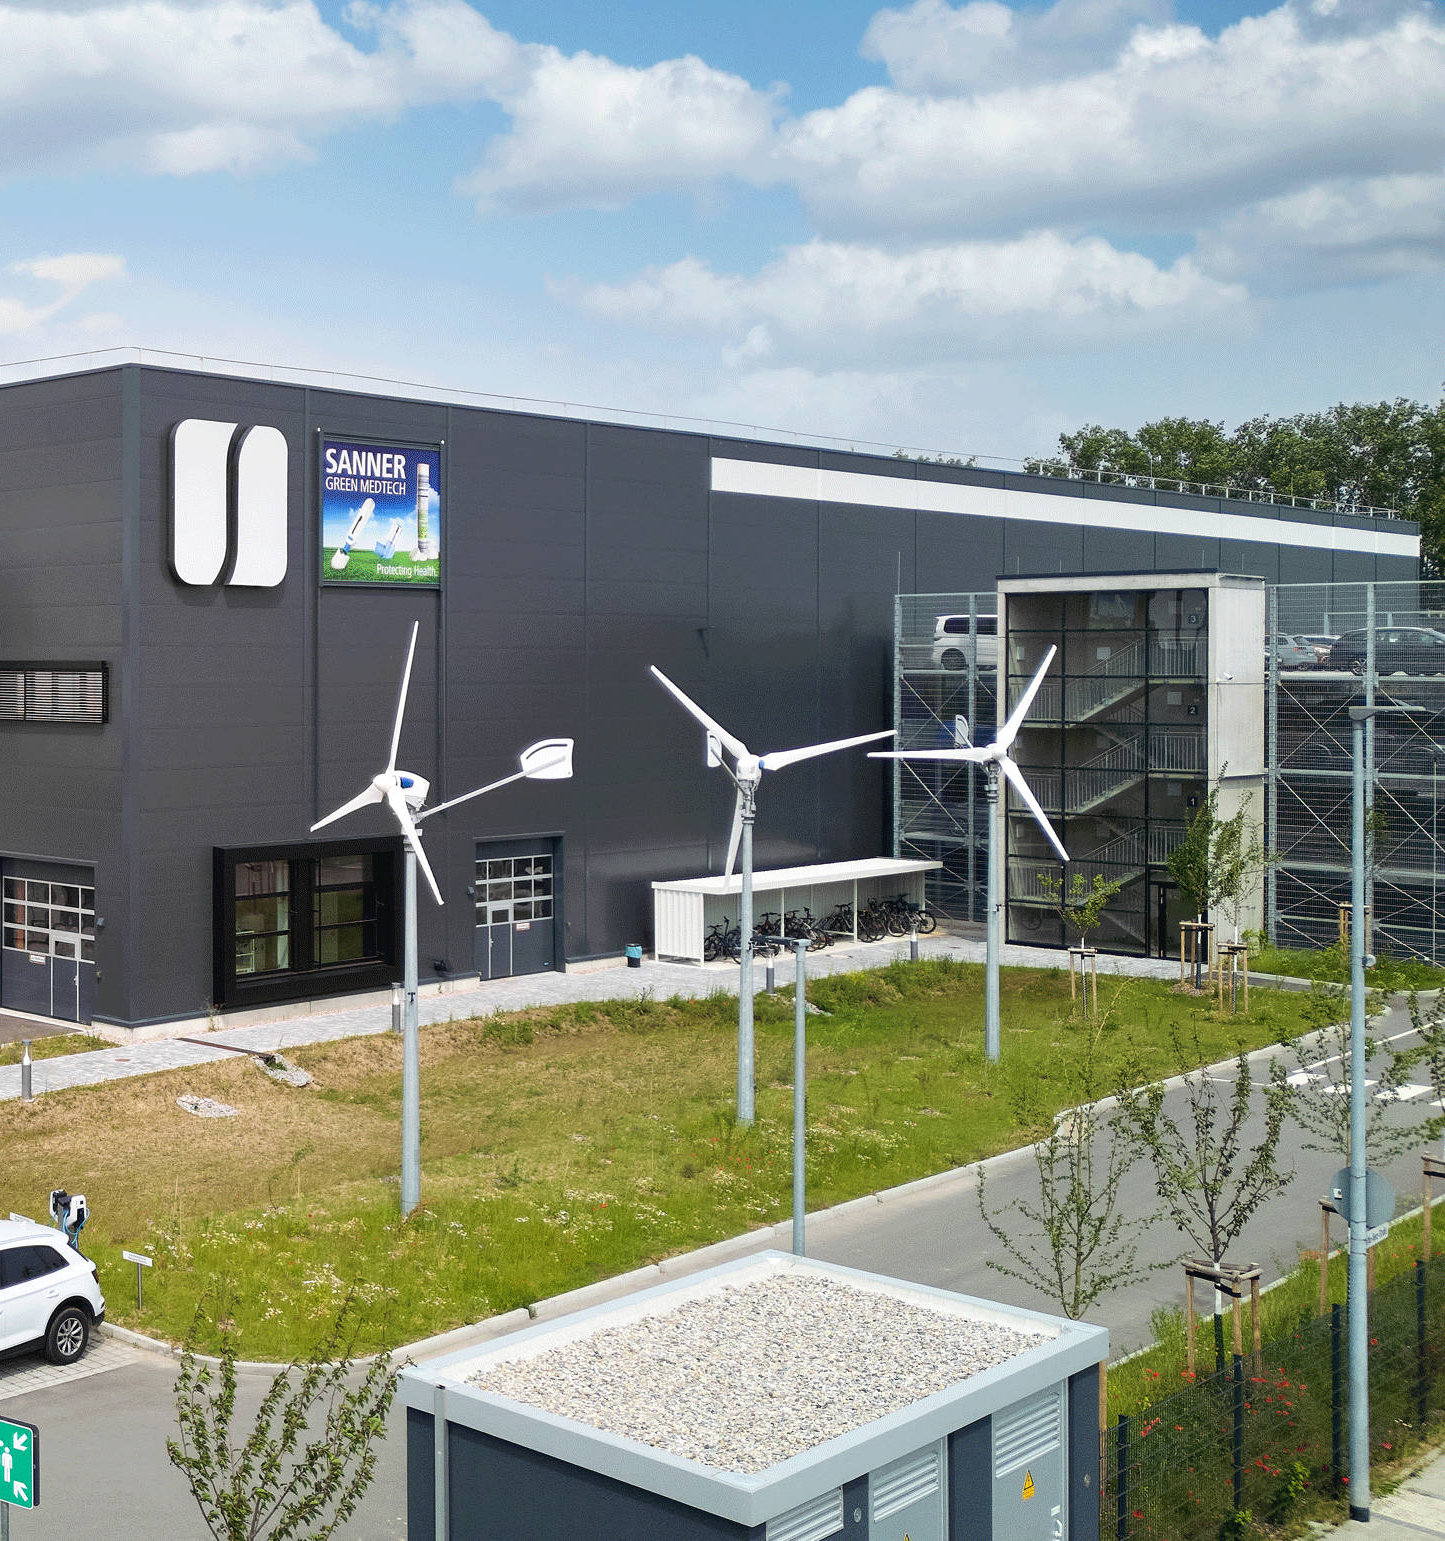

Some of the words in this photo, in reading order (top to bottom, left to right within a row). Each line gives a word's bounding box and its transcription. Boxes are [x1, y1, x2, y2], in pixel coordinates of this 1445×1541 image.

[325, 448, 406, 479] SANNER
[325, 476, 358, 492] GREEN
[360, 479, 406, 496] MEDTECH
[376, 563, 412, 578] Protecting
